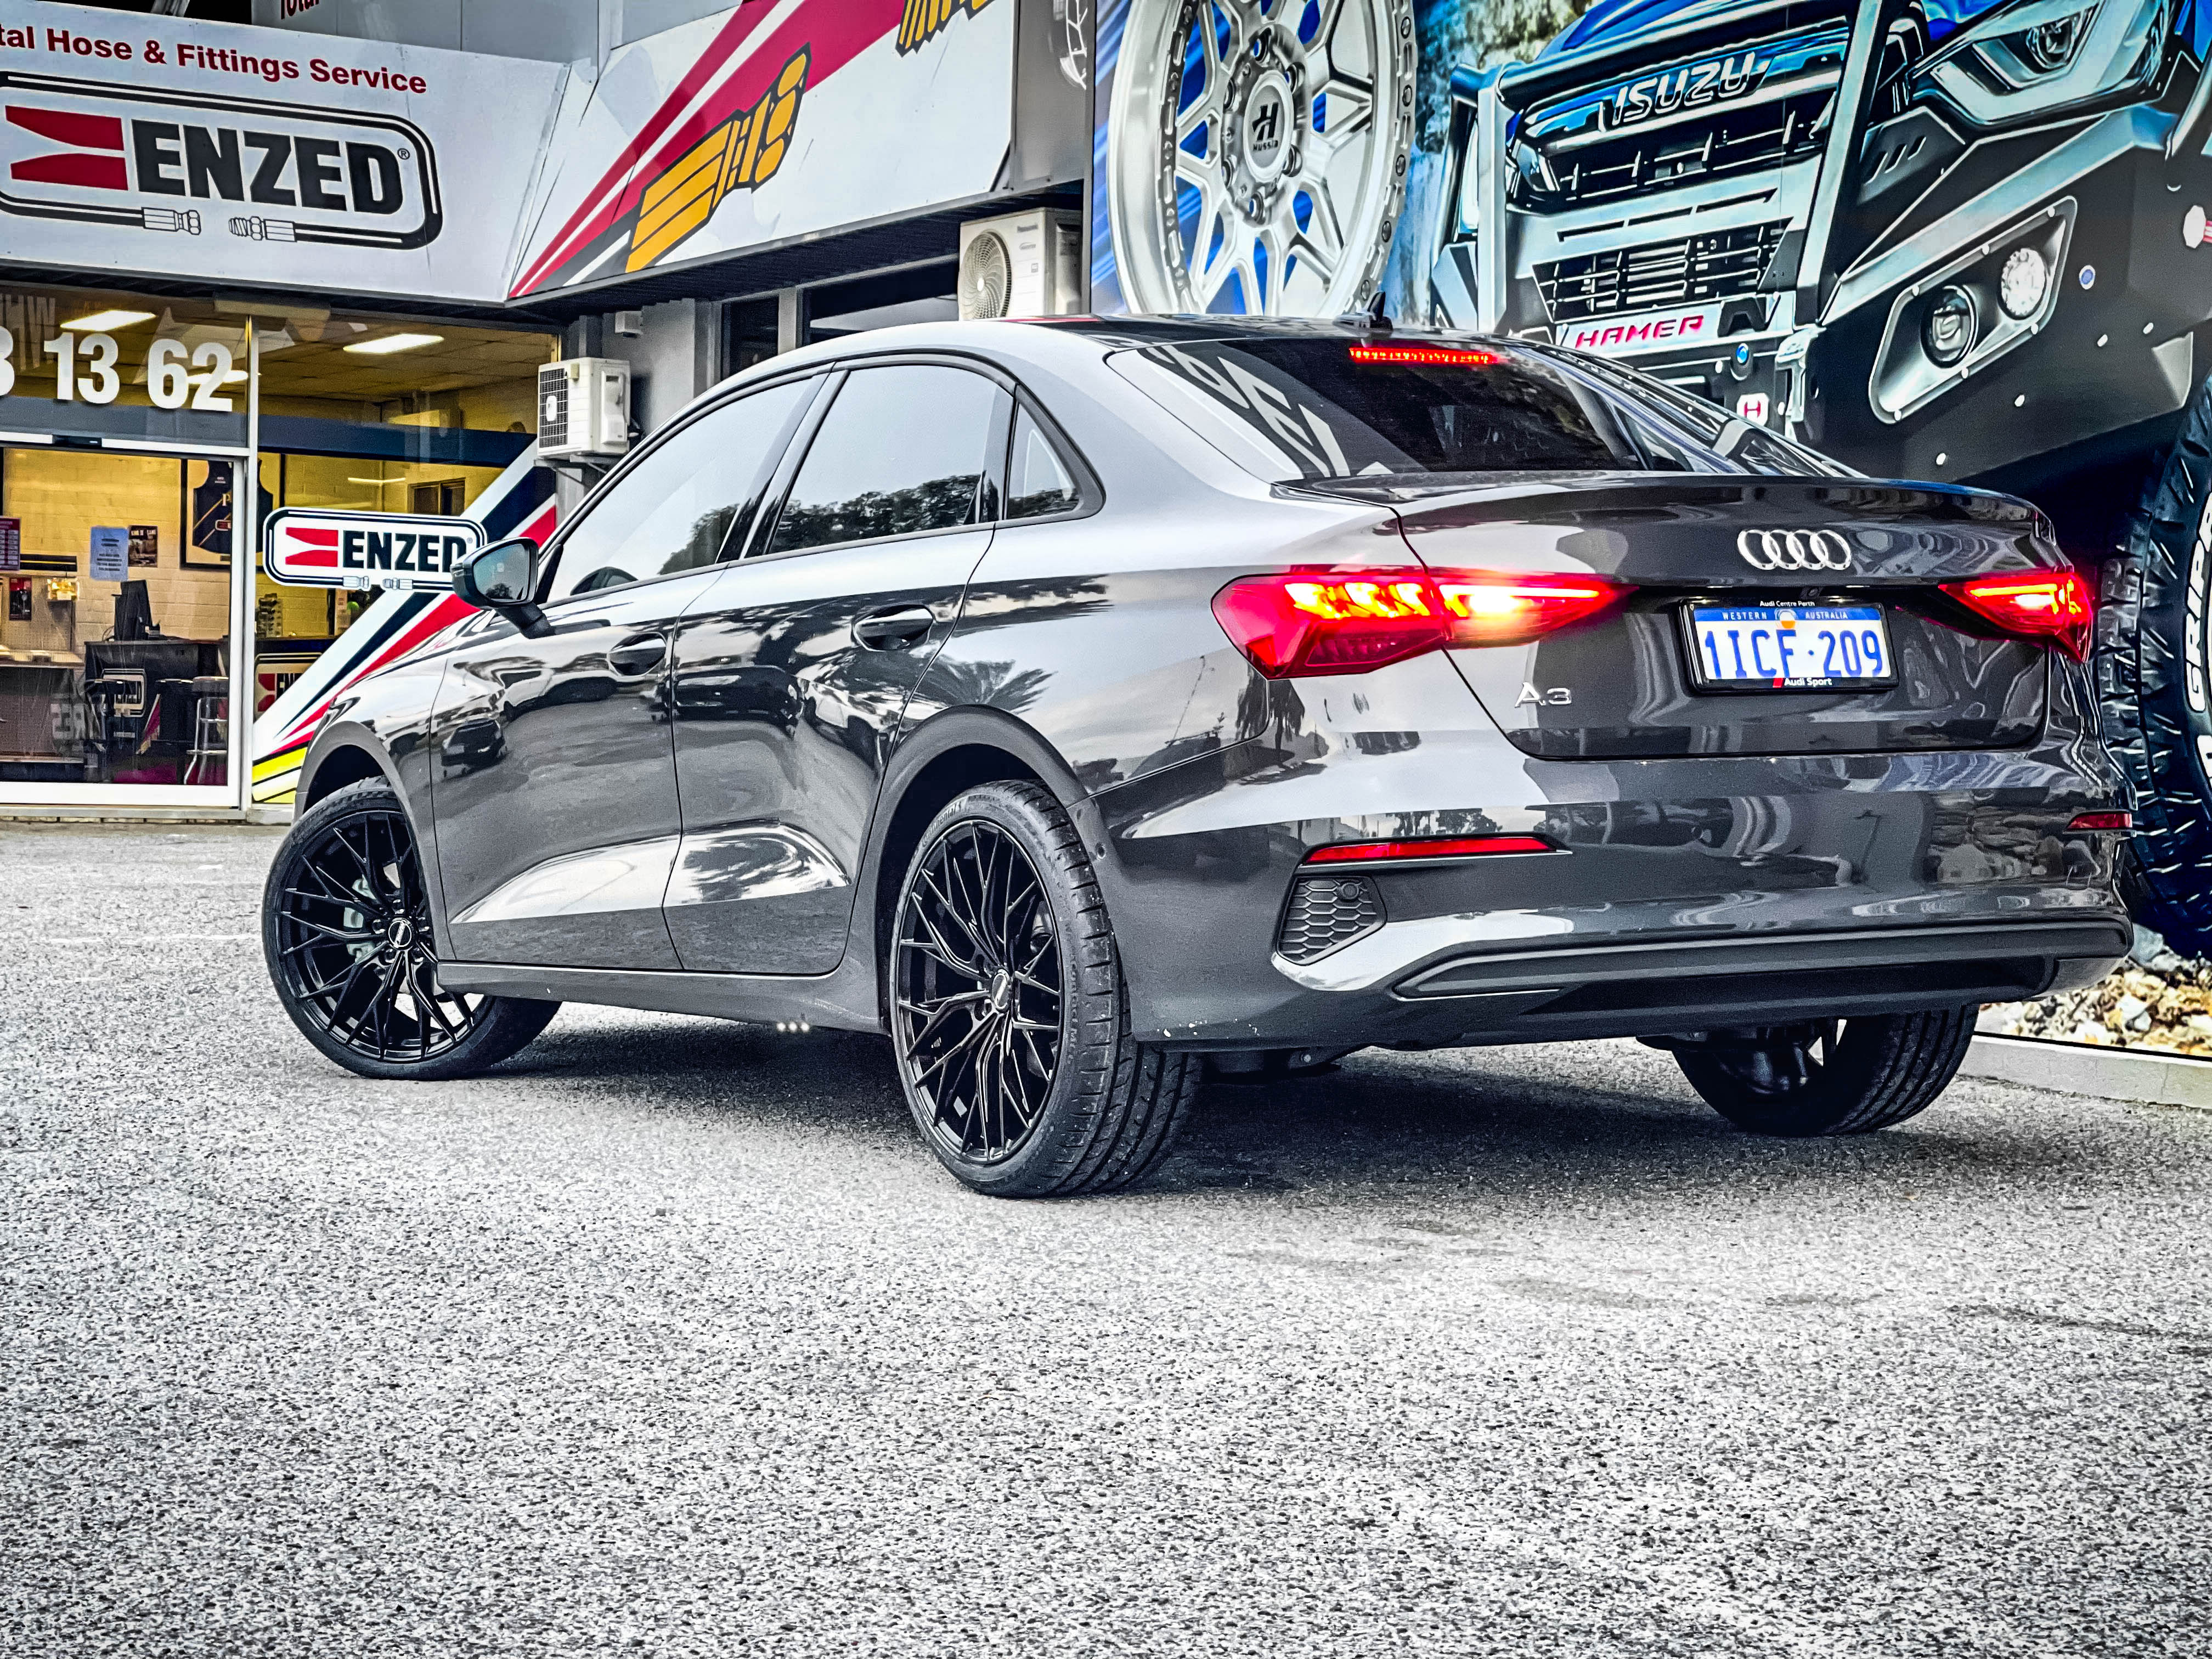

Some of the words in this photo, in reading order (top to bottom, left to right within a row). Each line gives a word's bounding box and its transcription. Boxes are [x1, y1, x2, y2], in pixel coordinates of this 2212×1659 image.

[47, 28, 132, 60] Hose
[144, 40, 167, 64] &
[177, 43, 300, 82] Fittings
[309, 58, 427, 94] Service
[1612, 50, 1756, 126] ISUZU
[1575, 315, 1704, 349] HAMER
[44, 332, 120, 404] 13
[148, 338, 233, 412] 62
[1722, 612, 1768, 620] WESTERN
[1805, 611, 1849, 620] AUSTRALIA
[1514, 682, 1572, 708] A3
[1784, 678, 1805, 686] Audi
[1806, 677, 1832, 687] Sport
